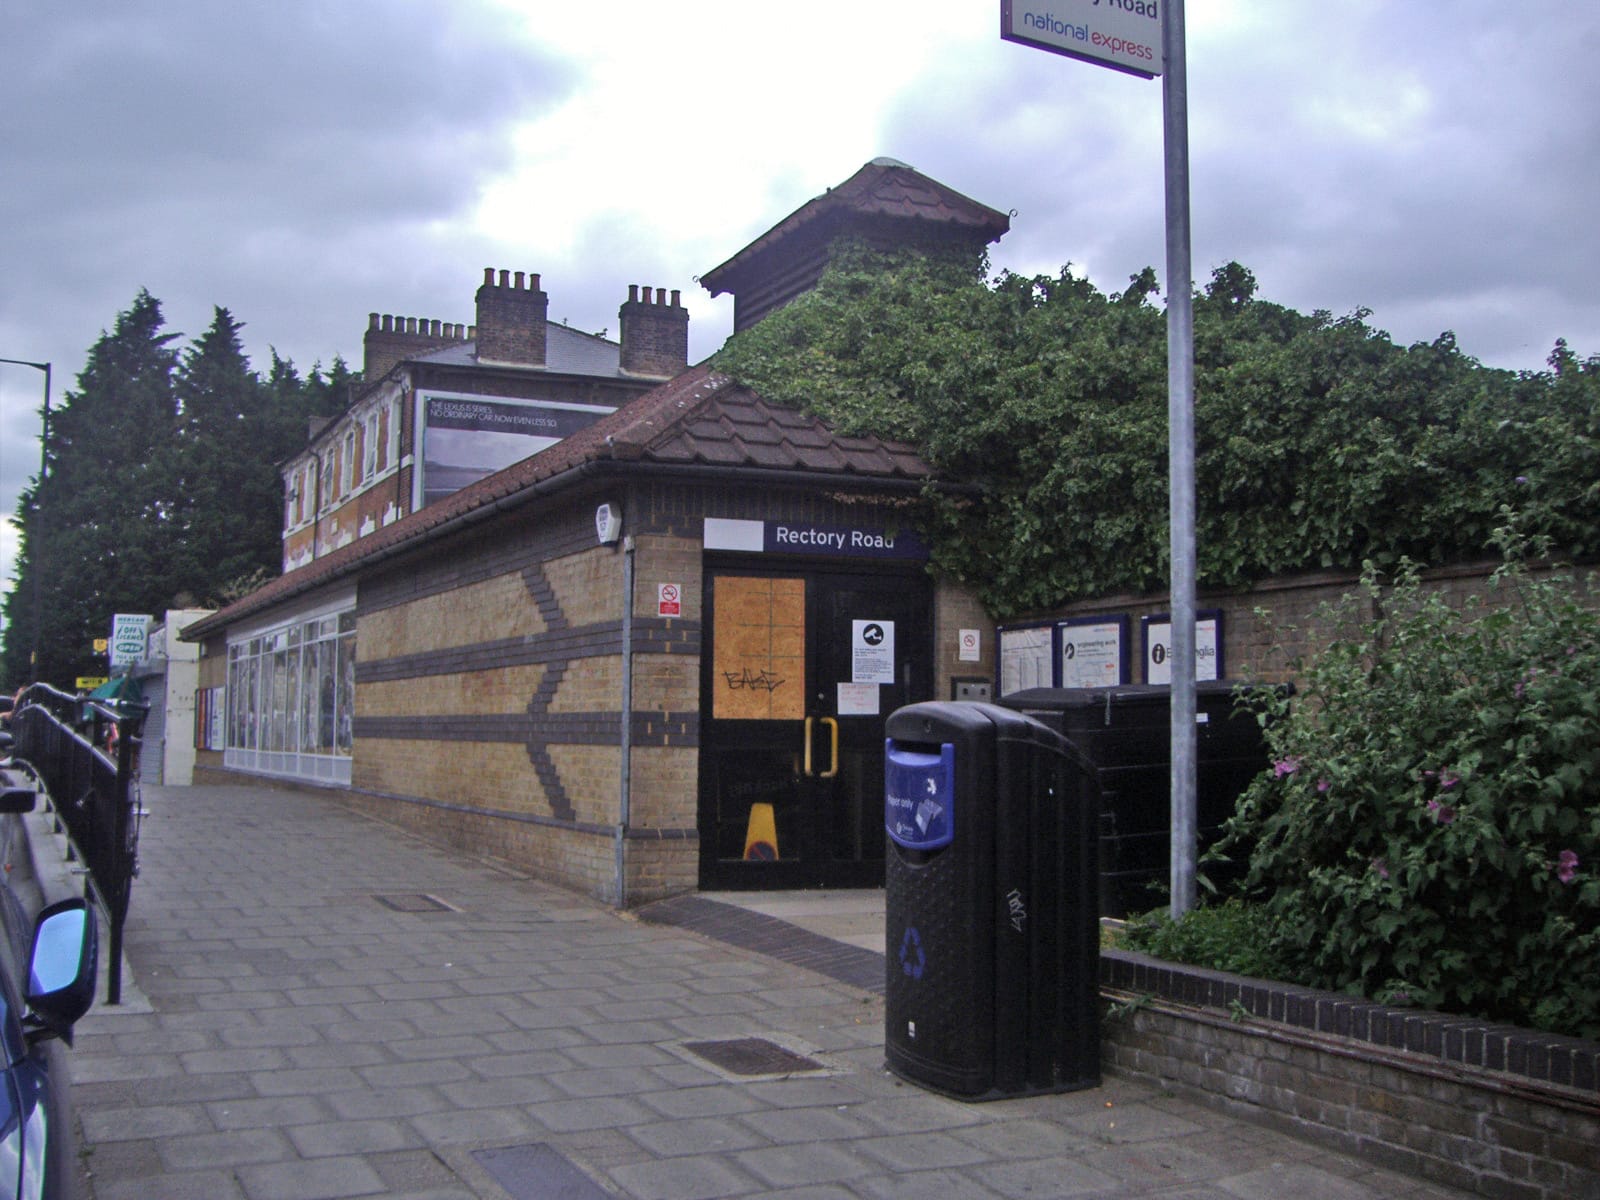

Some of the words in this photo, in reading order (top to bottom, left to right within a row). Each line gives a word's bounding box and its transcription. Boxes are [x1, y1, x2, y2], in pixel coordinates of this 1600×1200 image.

[1024, 12, 1089, 42] national
[1091, 31, 1153, 60] express
[430, 409, 444, 417] NO
[444, 410, 478, 420] ORDINARY
[494, 414, 514, 424] NOW
[776, 526, 845, 550] Rectory
[851, 531, 894, 549] Road
